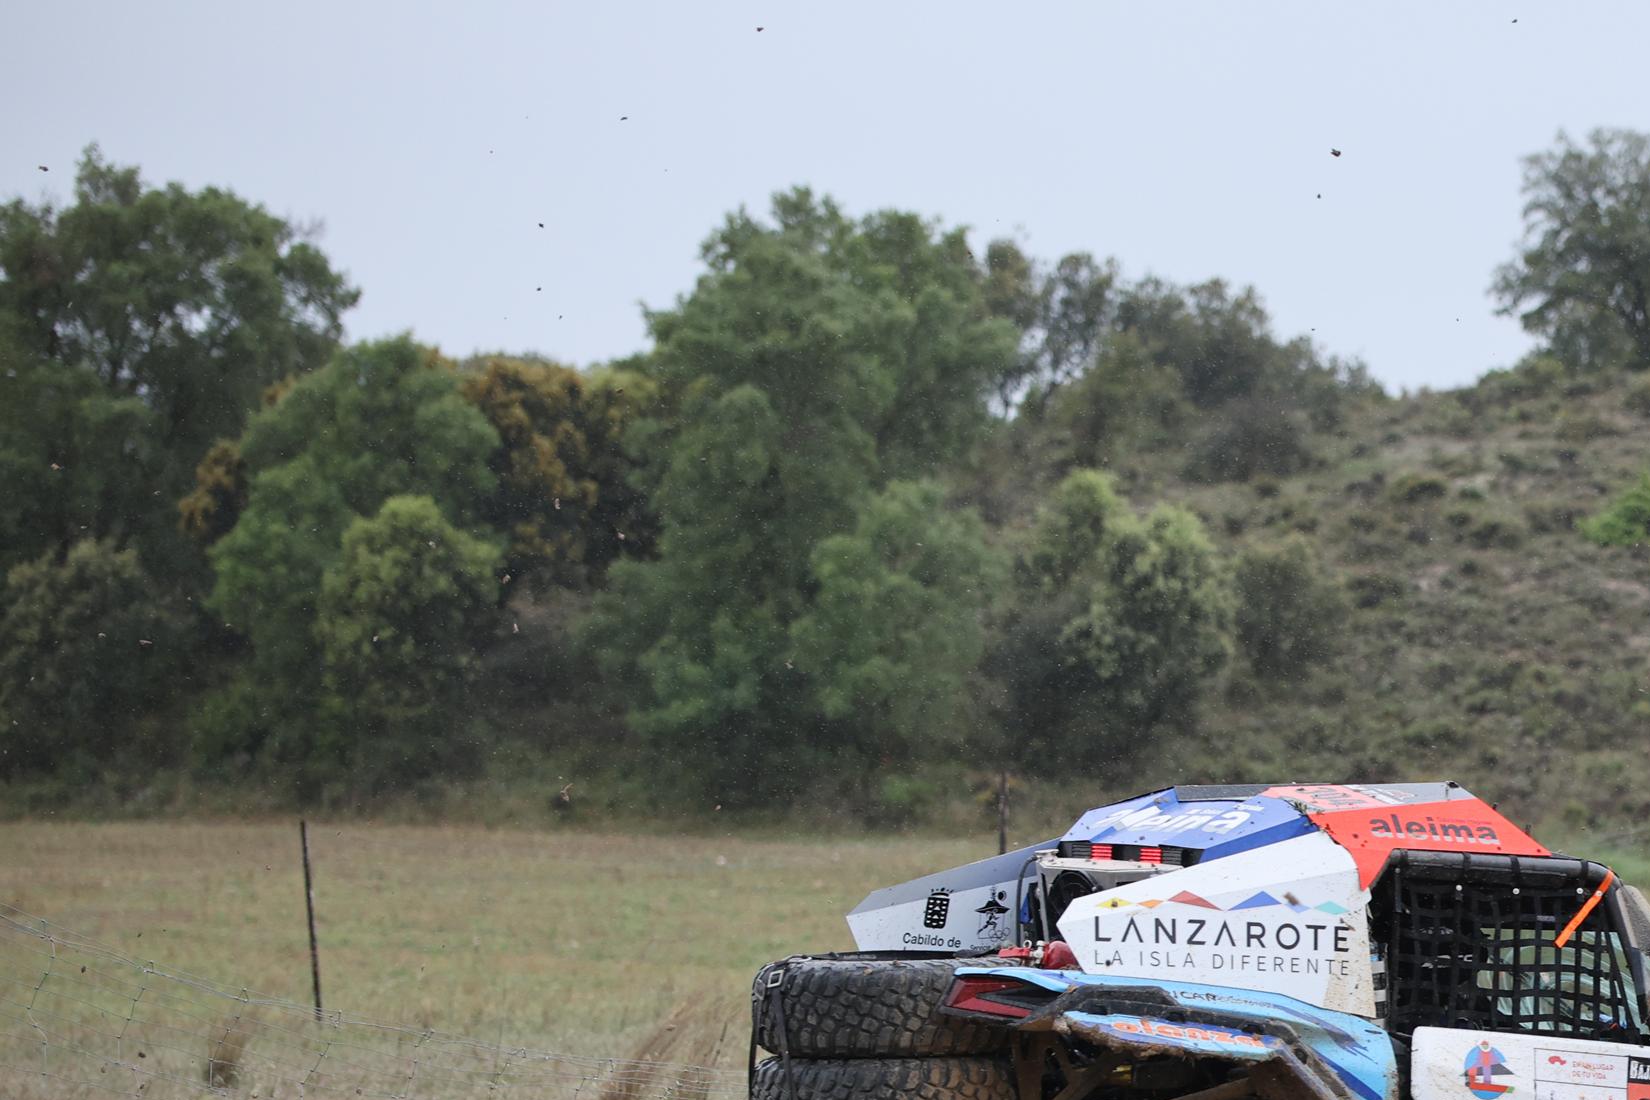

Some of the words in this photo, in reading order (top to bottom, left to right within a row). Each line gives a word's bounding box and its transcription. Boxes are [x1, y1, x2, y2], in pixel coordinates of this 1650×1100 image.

[1369, 814, 1500, 845] aleima
[903, 932, 945, 946] Cabildo
[947, 937, 961, 948] de
[1094, 915, 1350, 953] LANZAROTE
[1094, 950, 1124, 966] LA
[1140, 951, 1195, 968] ISLA
[1212, 953, 1350, 976] DIFERENTE
